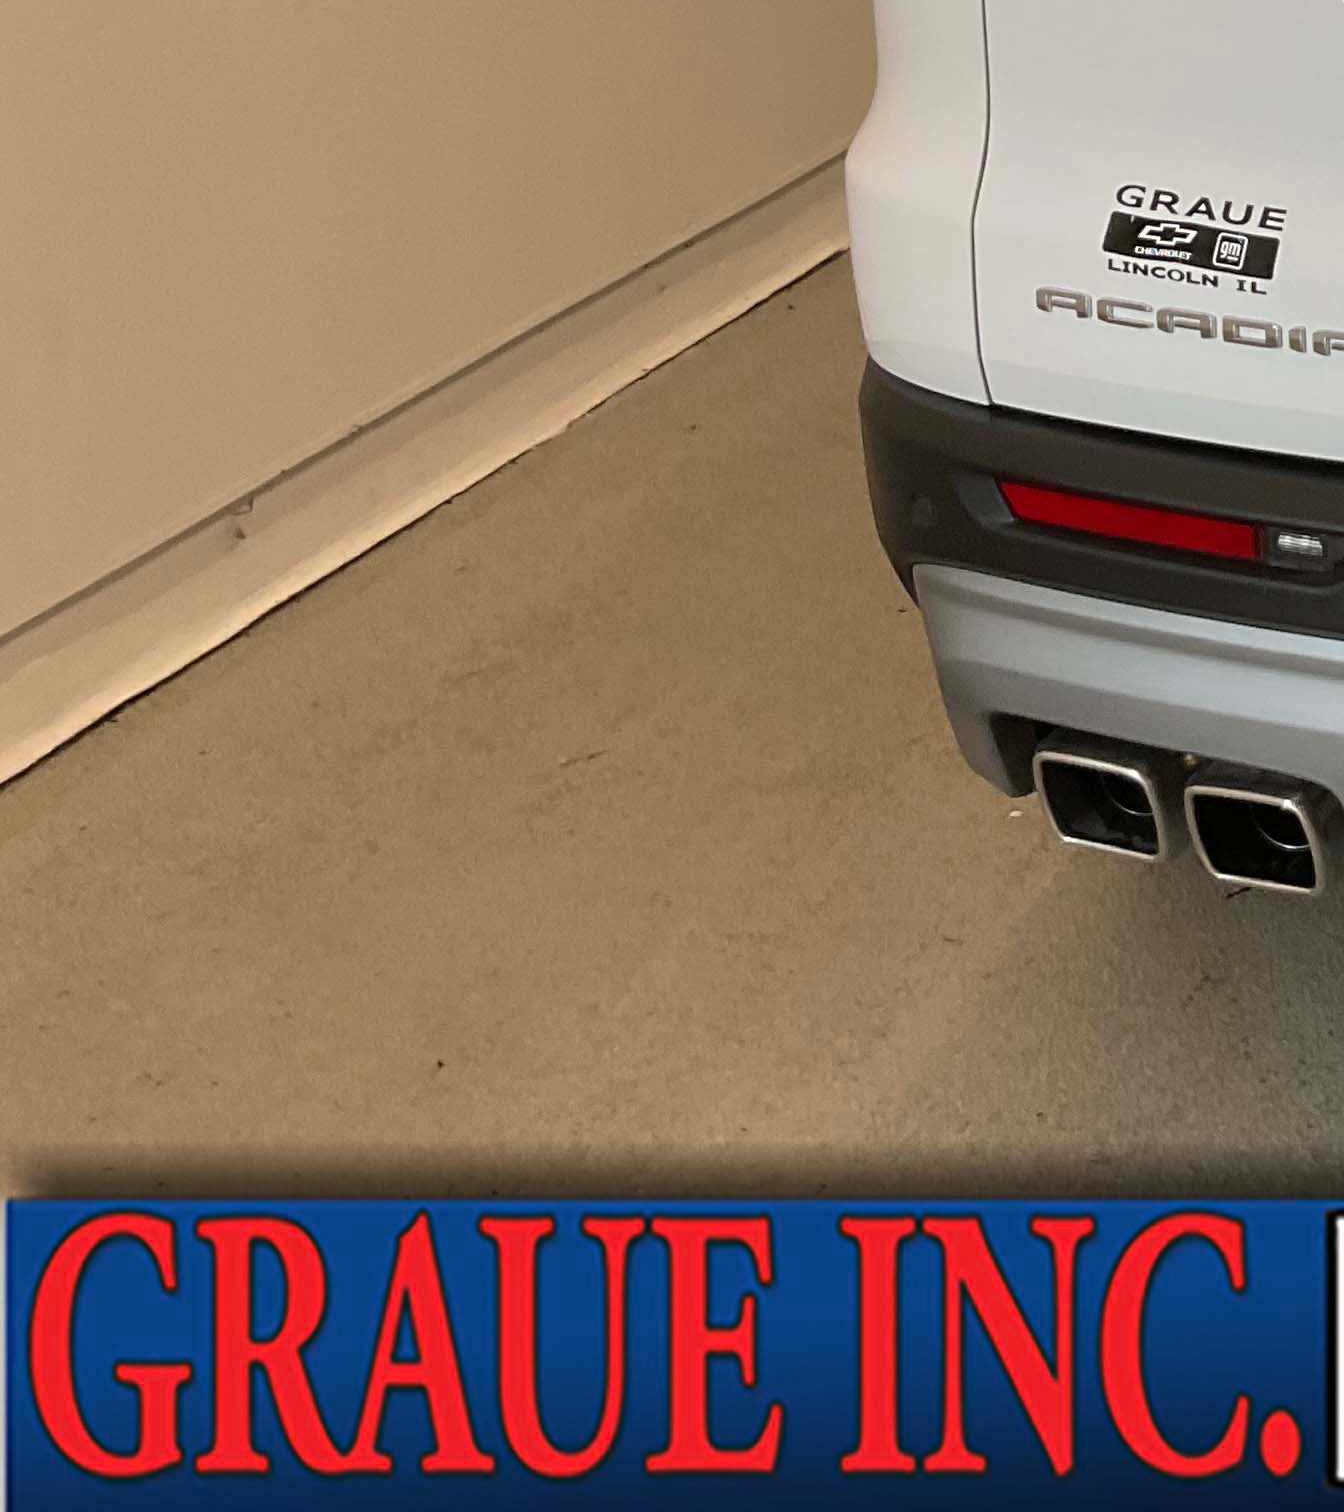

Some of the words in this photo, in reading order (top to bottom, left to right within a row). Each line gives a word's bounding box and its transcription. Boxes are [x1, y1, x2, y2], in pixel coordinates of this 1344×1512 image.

[1115, 184, 1288, 232] GRAUE
[1134, 244, 1192, 260] CHEVROLET
[1108, 258, 1219, 288] LINCOLN
[1236, 279, 1267, 295] IL
